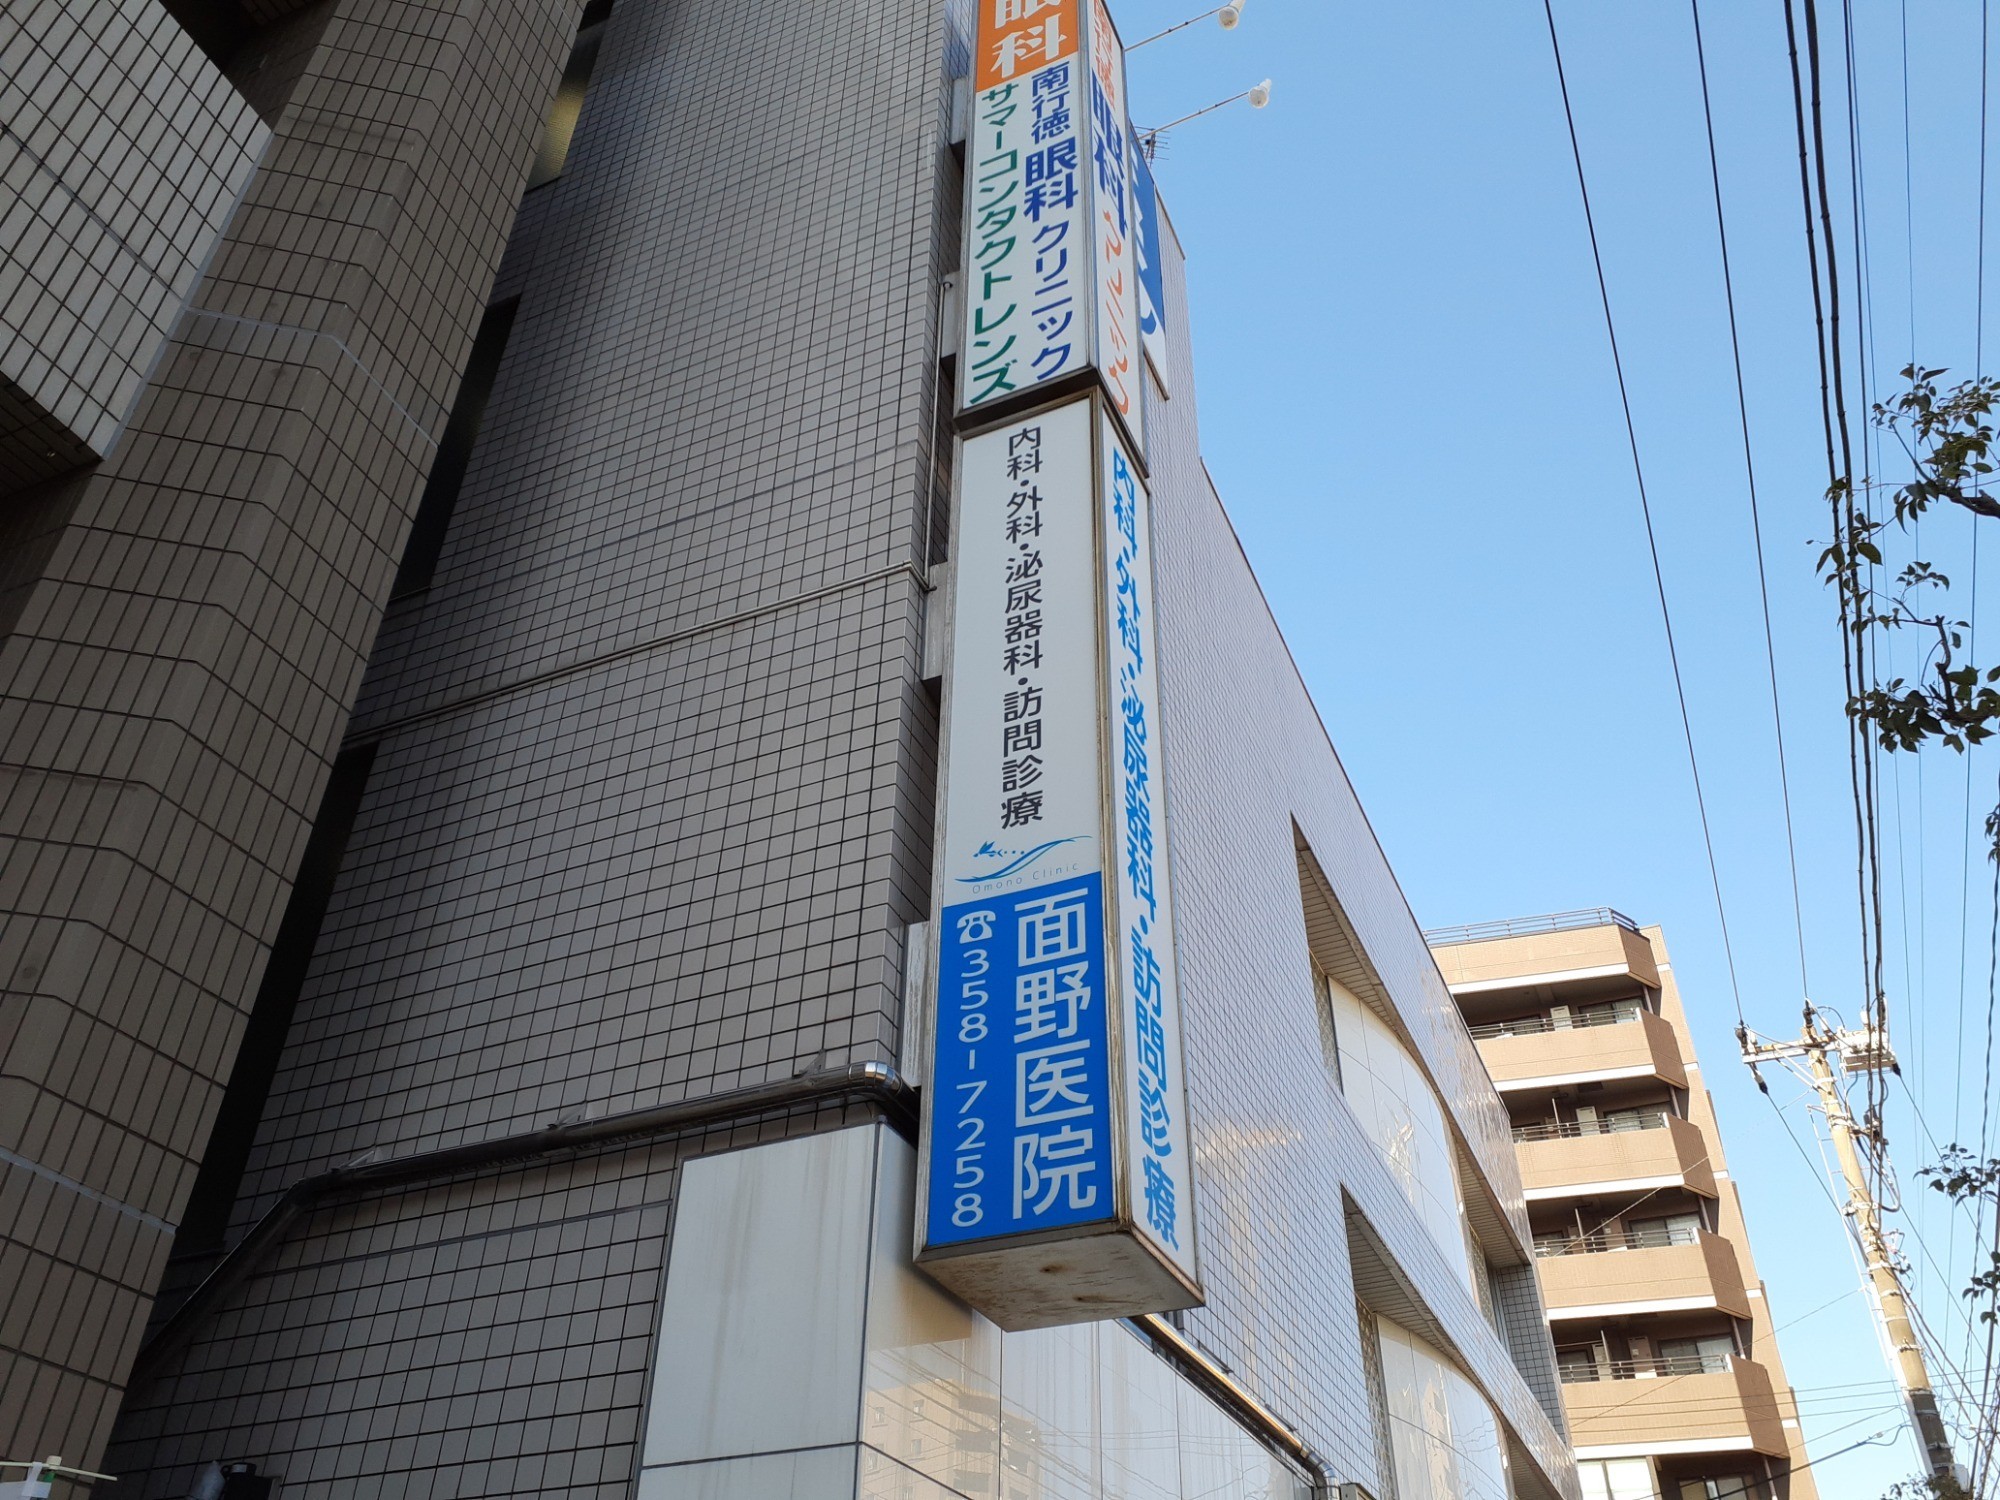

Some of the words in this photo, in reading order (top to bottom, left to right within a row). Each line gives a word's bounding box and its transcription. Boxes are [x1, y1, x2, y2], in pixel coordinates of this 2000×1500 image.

[969, 83, 1020, 405] サマーコンタクトレンズ
[1023, 60, 1079, 381] 南行徳眼科クリニック
[971, 877, 1023, 895] Omono
[1032, 862, 1080, 881] Clinic
[1012, 886, 1098, 1220] 面野医院
